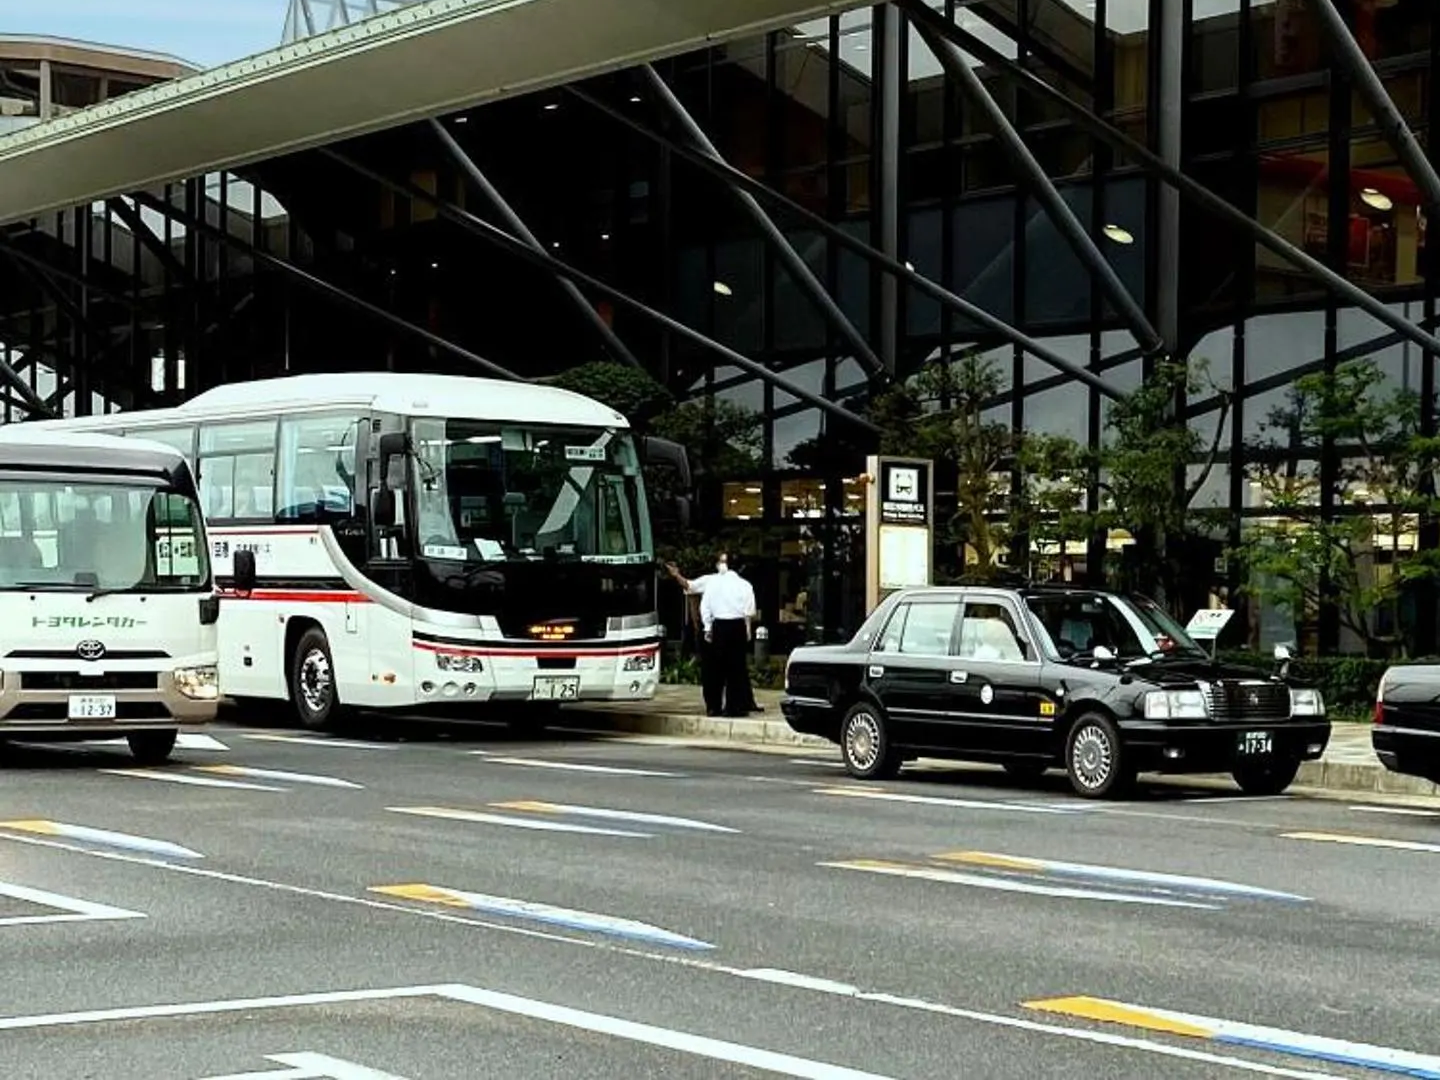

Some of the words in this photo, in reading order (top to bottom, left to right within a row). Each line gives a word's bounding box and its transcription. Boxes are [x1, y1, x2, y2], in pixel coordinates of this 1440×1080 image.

[32, 616, 148, 628] トヨタレンタカー
